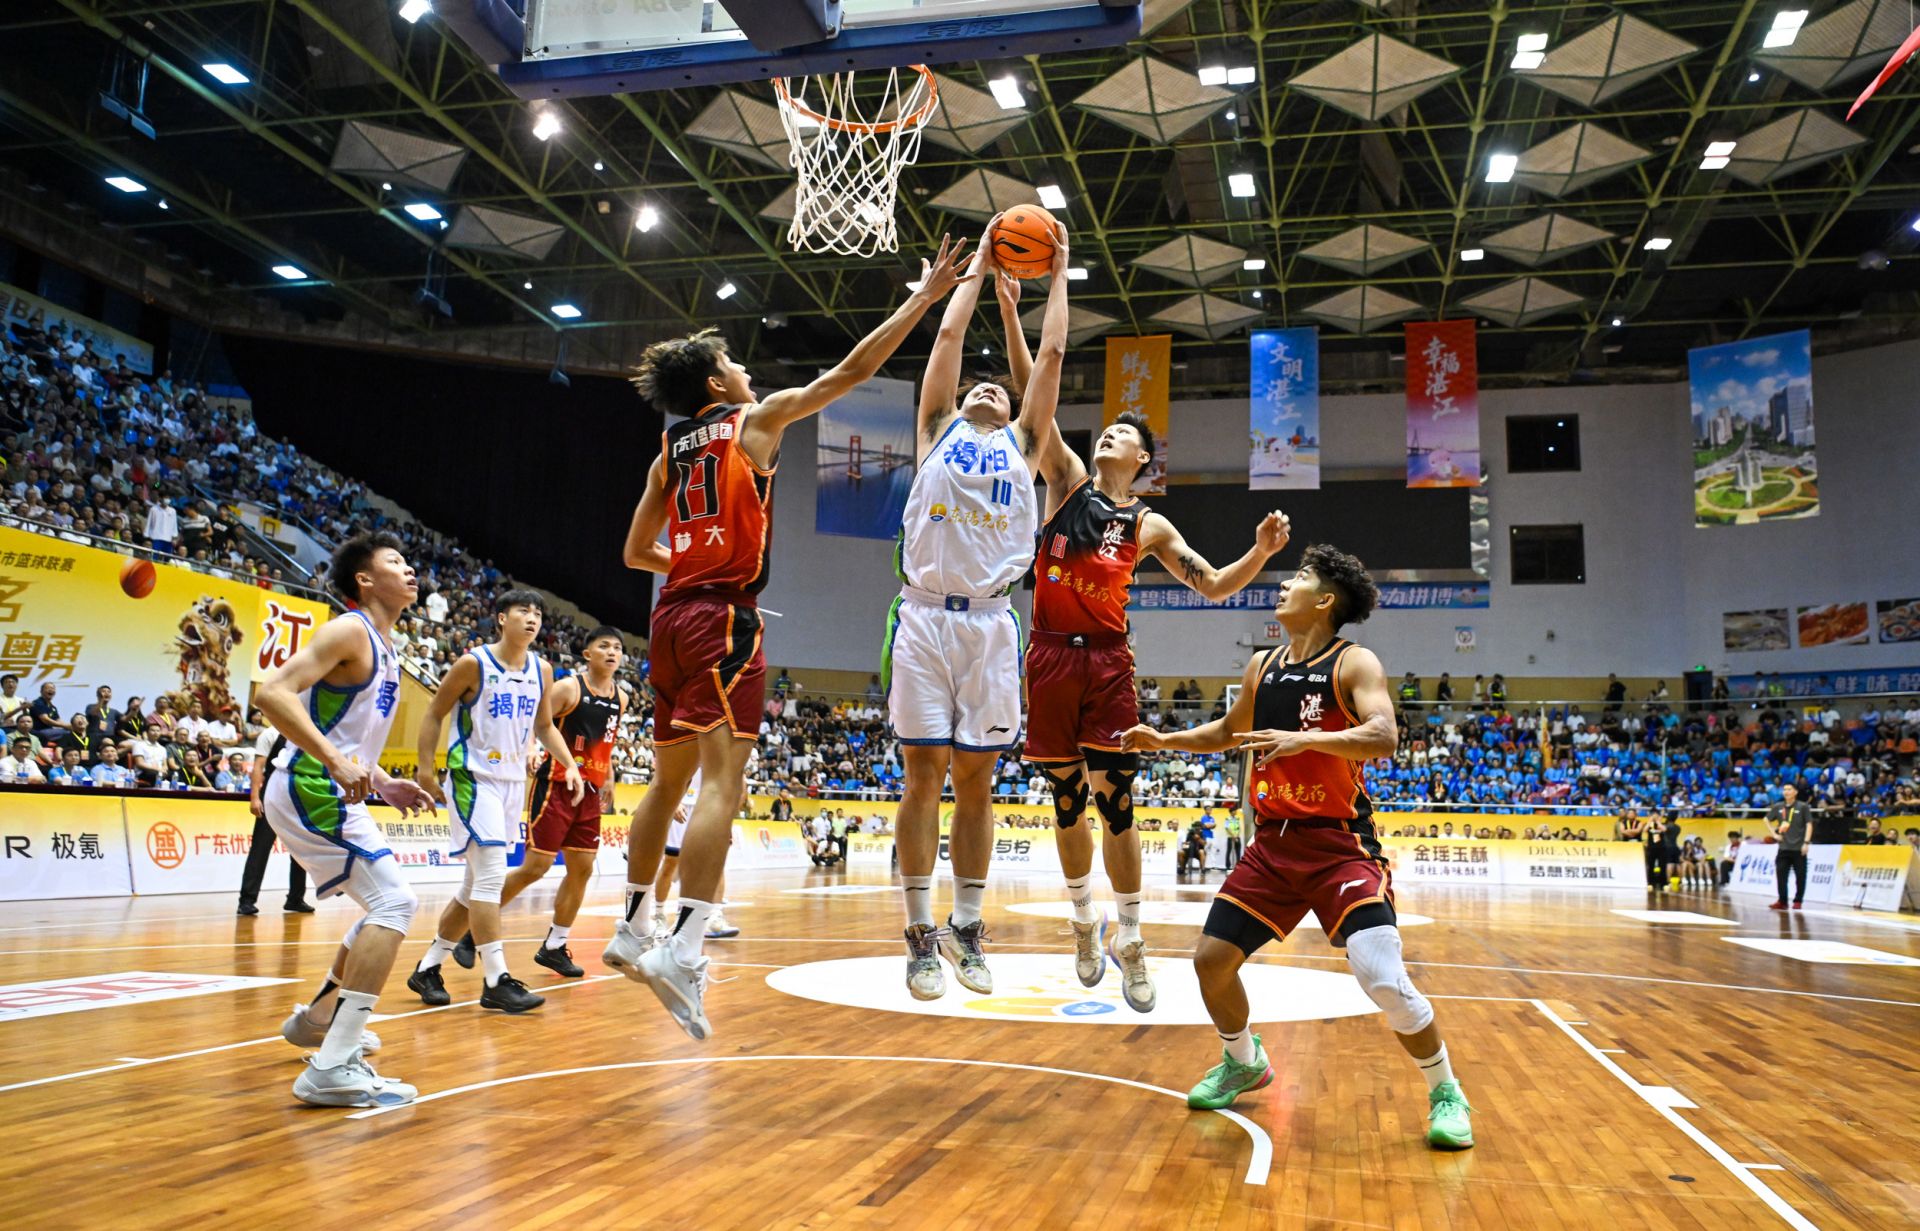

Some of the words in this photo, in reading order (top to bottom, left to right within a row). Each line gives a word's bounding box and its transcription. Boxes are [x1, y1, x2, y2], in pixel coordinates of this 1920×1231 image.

[1266, 342, 1302, 425] 文明湛江
[1422, 336, 1460, 421] 幸福湛江
[1098, 520, 1125, 561] 湛江
[488, 692, 536, 719] 揭阳
[6, 836, 32, 858] R
[51, 832, 104, 859] 极氪
[1413, 844, 1488, 863] 金瑶玉酥
[1529, 846, 1607, 857] DREAMER
